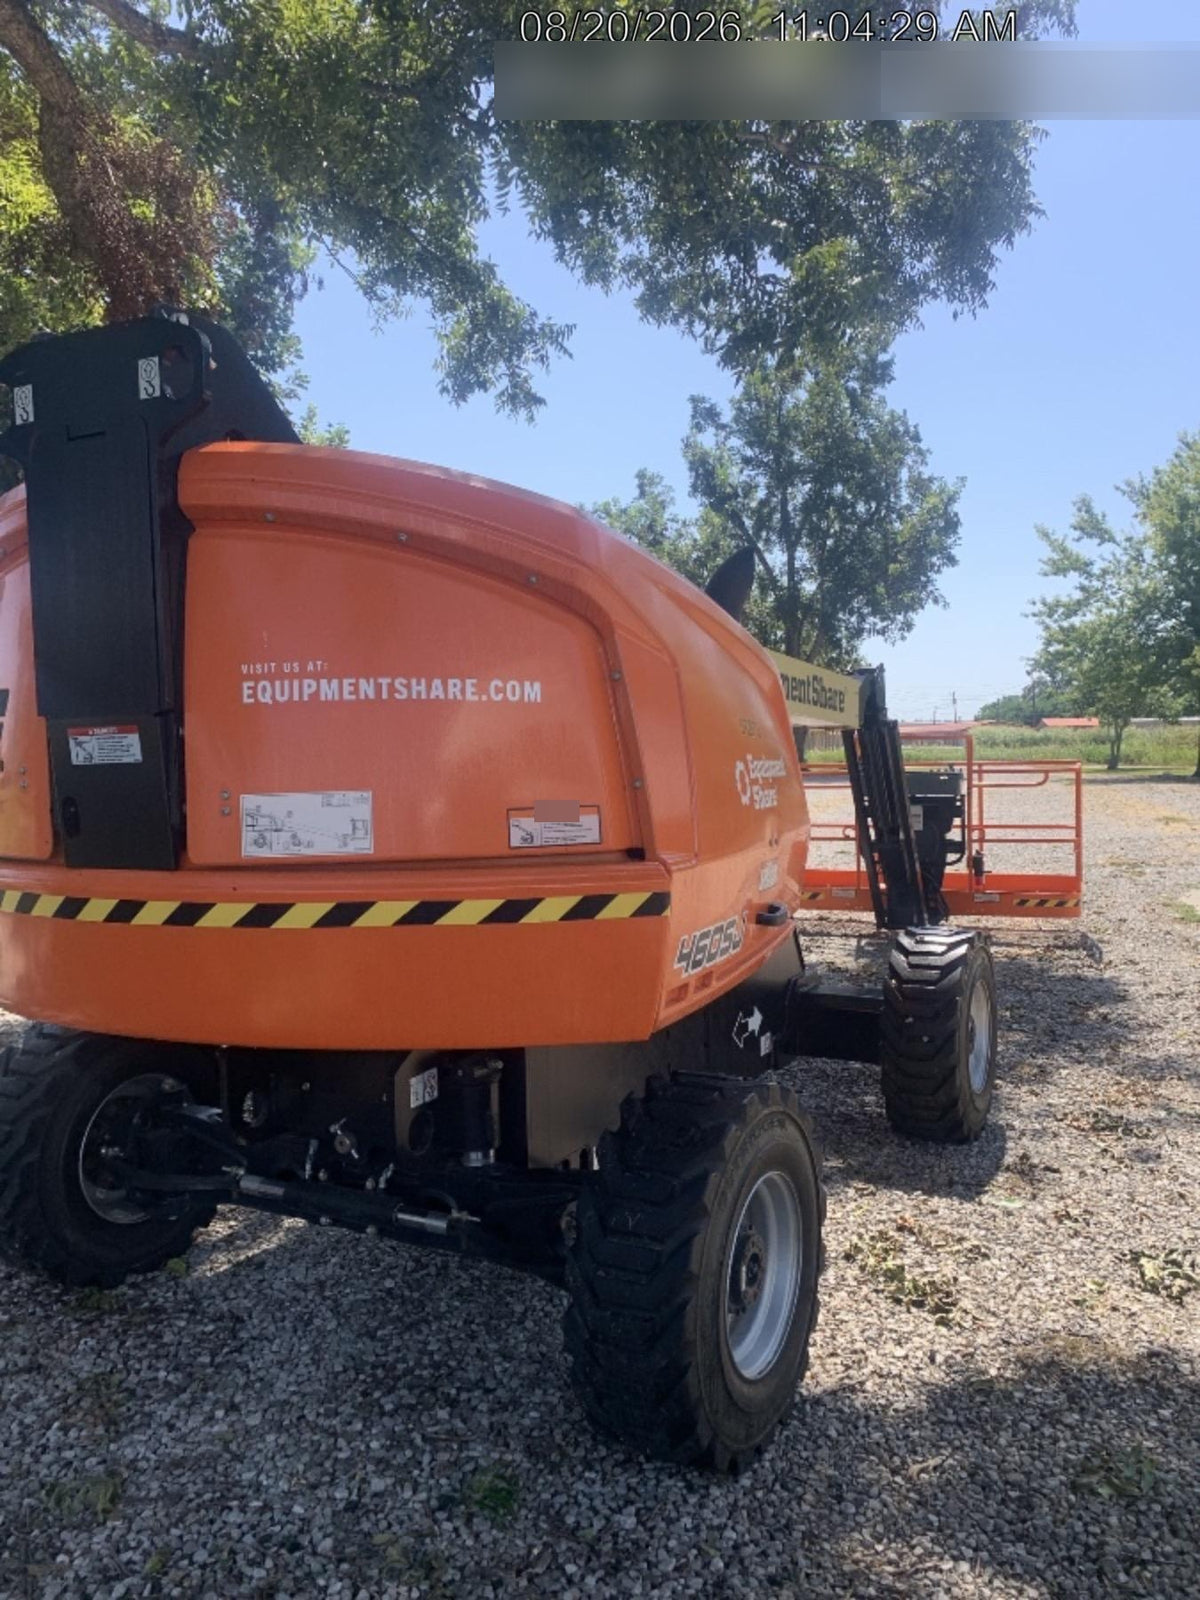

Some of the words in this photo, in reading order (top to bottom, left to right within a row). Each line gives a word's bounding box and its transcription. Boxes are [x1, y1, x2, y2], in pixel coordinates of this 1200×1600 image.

[241, 662, 277, 675] VISIT
[283, 662, 300, 674] US
[242, 676, 542, 705] EQUIPMENTSHARE.COM
[780, 672, 846, 714] mentShare
